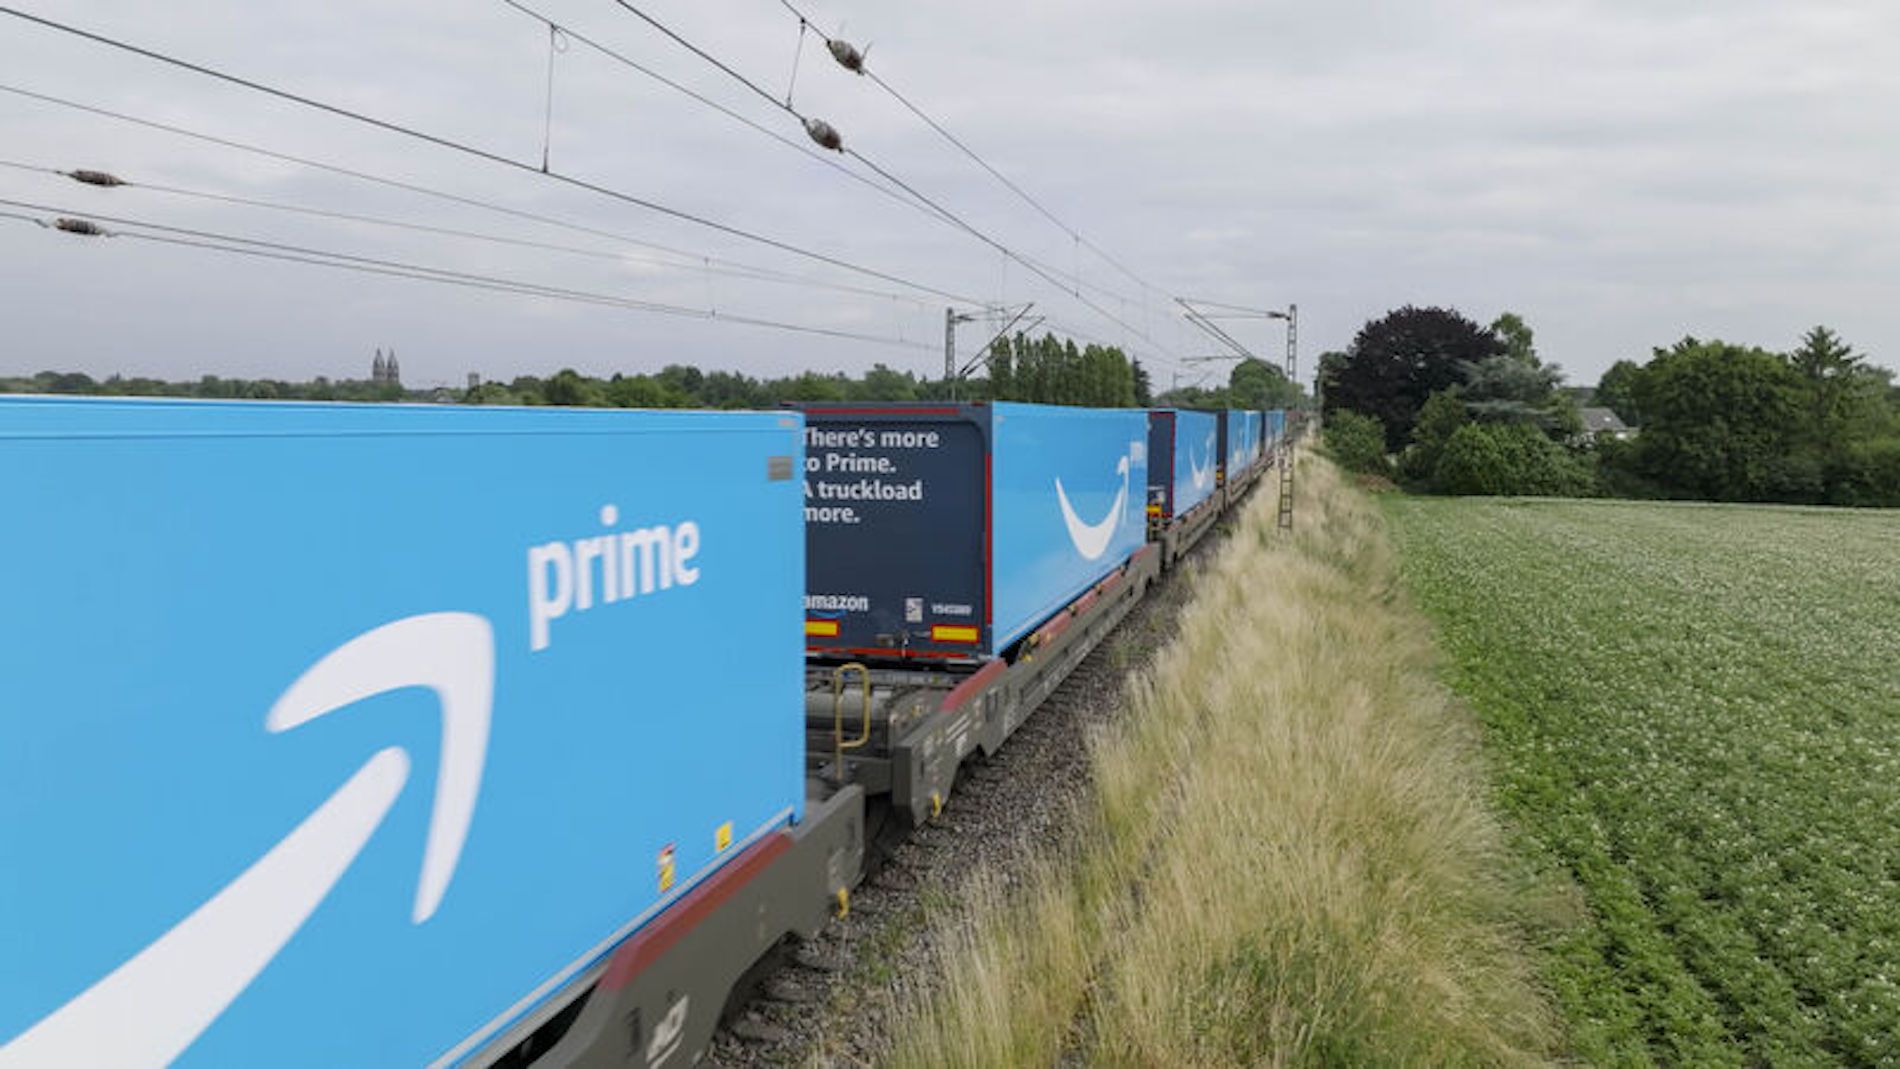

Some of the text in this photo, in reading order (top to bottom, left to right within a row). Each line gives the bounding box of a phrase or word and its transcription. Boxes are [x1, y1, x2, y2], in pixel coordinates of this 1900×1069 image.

[881, 431, 940, 448] more
[804, 452, 897, 473] o Prime.
[817, 479, 923, 500] truckload
[528, 504, 700, 652] prime
